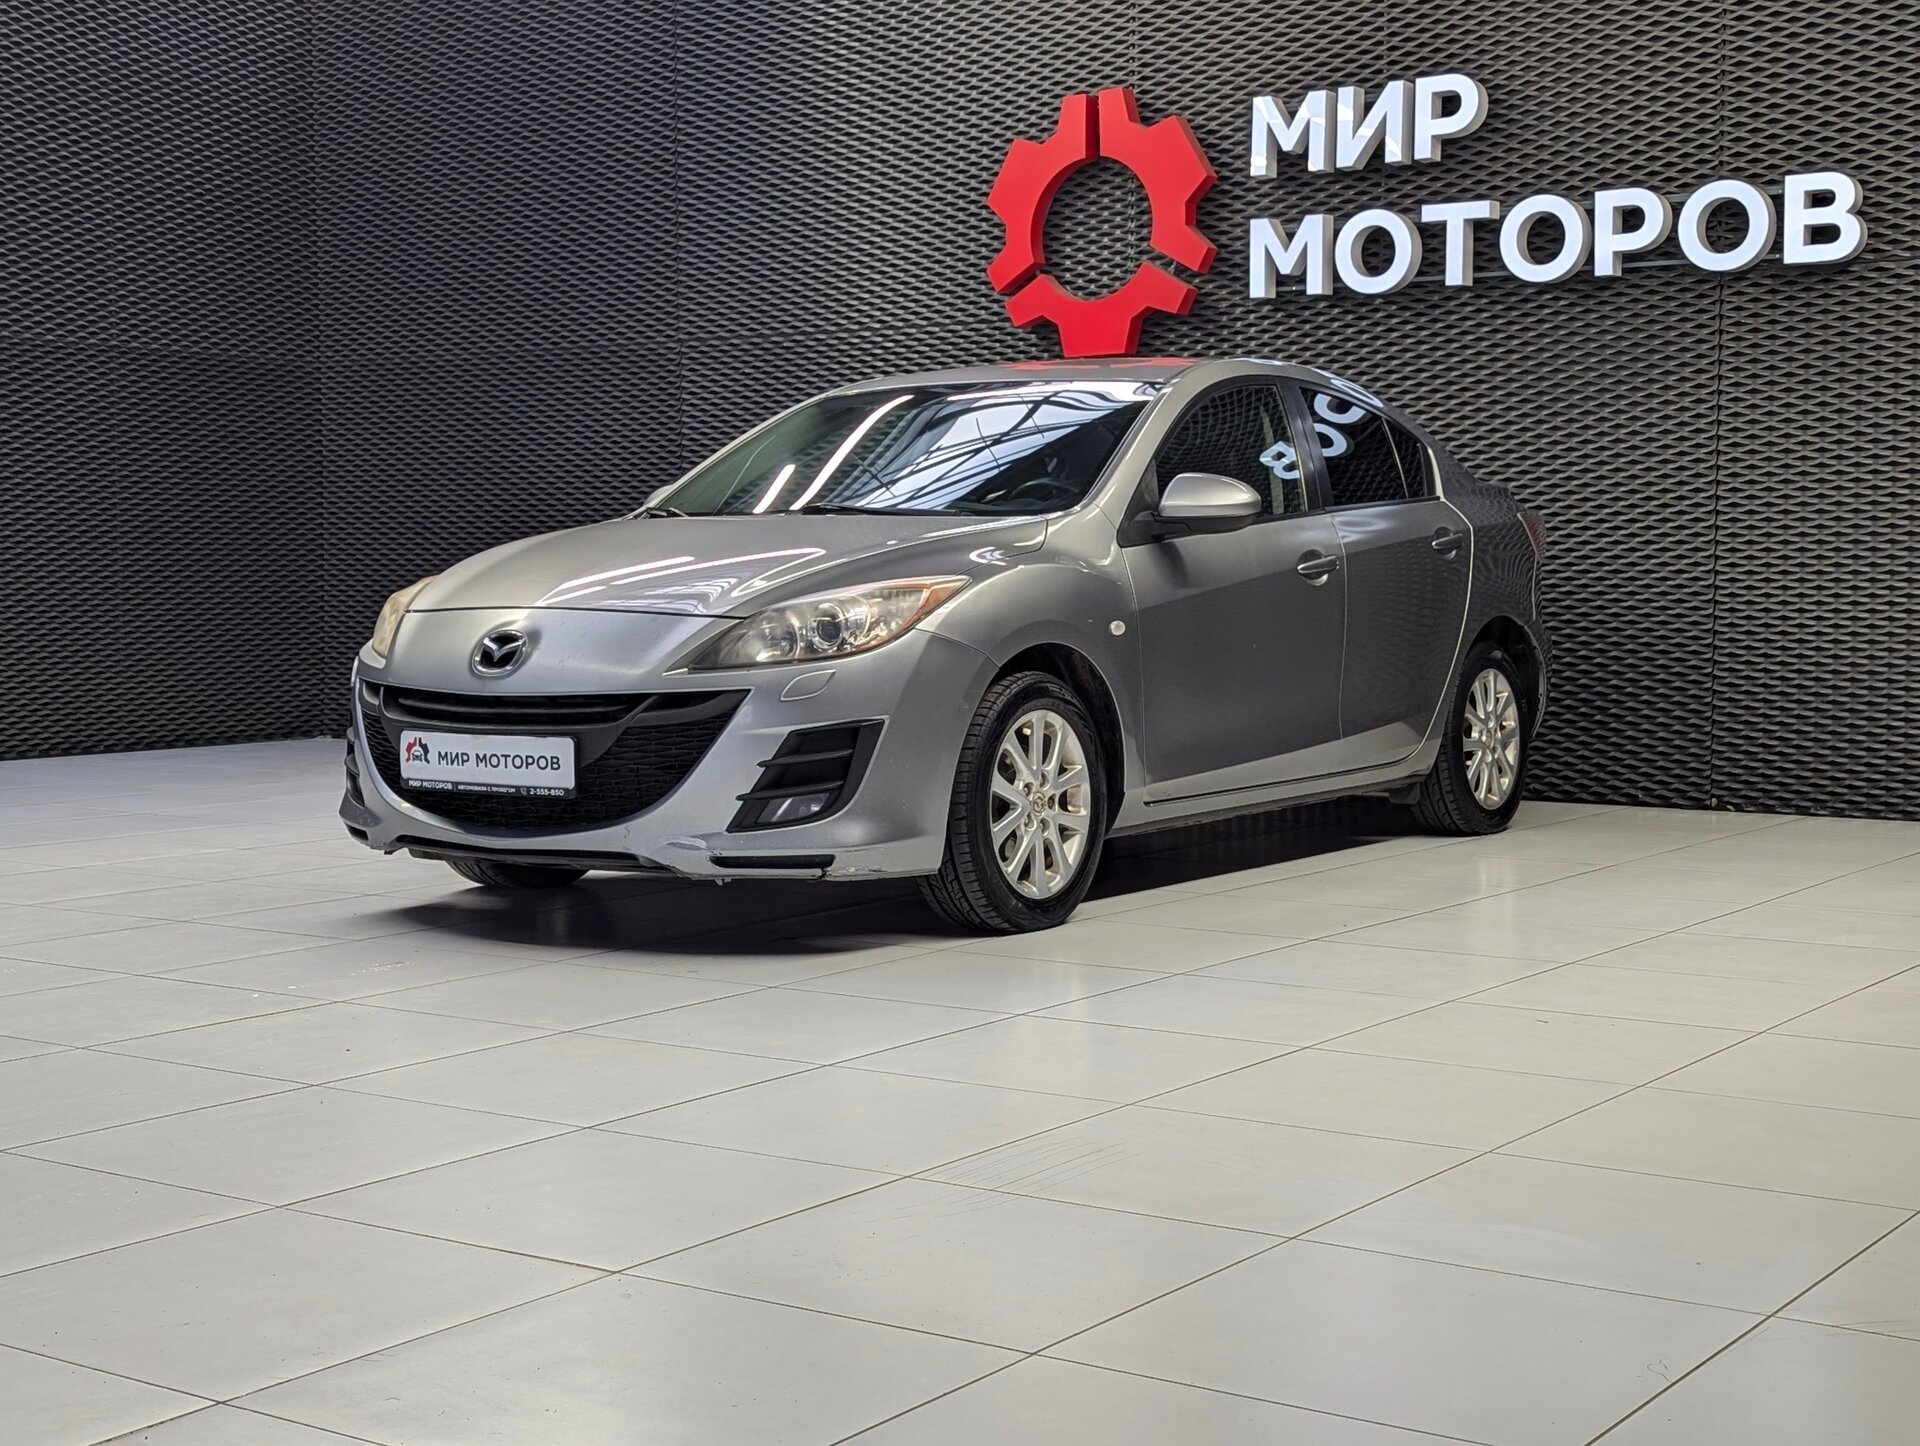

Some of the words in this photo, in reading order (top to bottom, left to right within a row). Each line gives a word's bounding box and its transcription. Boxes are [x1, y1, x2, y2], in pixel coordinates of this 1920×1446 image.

[1250, 73, 1487, 177] МИР
[1249, 171, 1867, 298] МОТОРОВ
[422, 781, 453, 790] МОТОРОВ
[438, 751, 470, 767] МИР
[476, 753, 561, 771] МОТОРОВ
